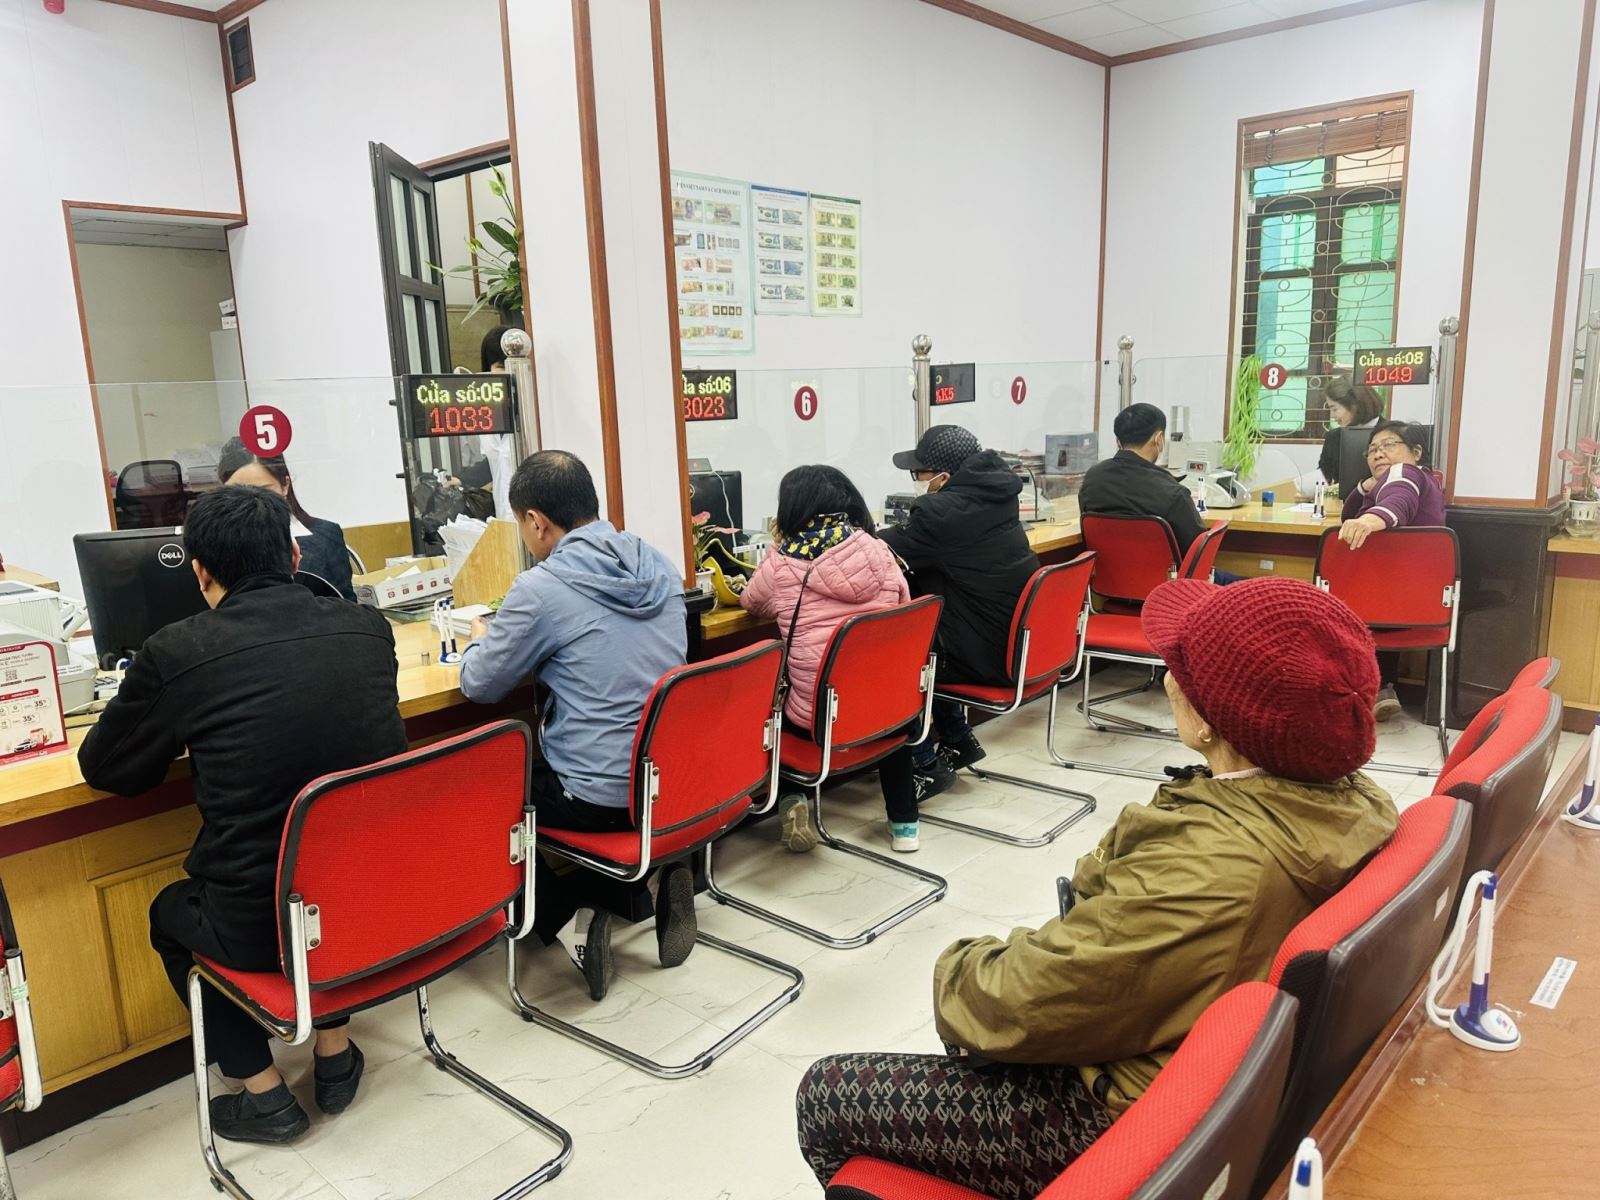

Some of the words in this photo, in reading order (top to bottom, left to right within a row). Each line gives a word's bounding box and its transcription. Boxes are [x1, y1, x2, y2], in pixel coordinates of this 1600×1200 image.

[1267, 367, 1279, 387] 8
[1365, 366, 1412, 384] 1049
[1015, 381, 1023, 401] 7
[801, 391, 811, 416] 6
[430, 405, 494, 433] 1033
[254, 413, 278, 450] 5
[161, 552, 182, 560] DELL
